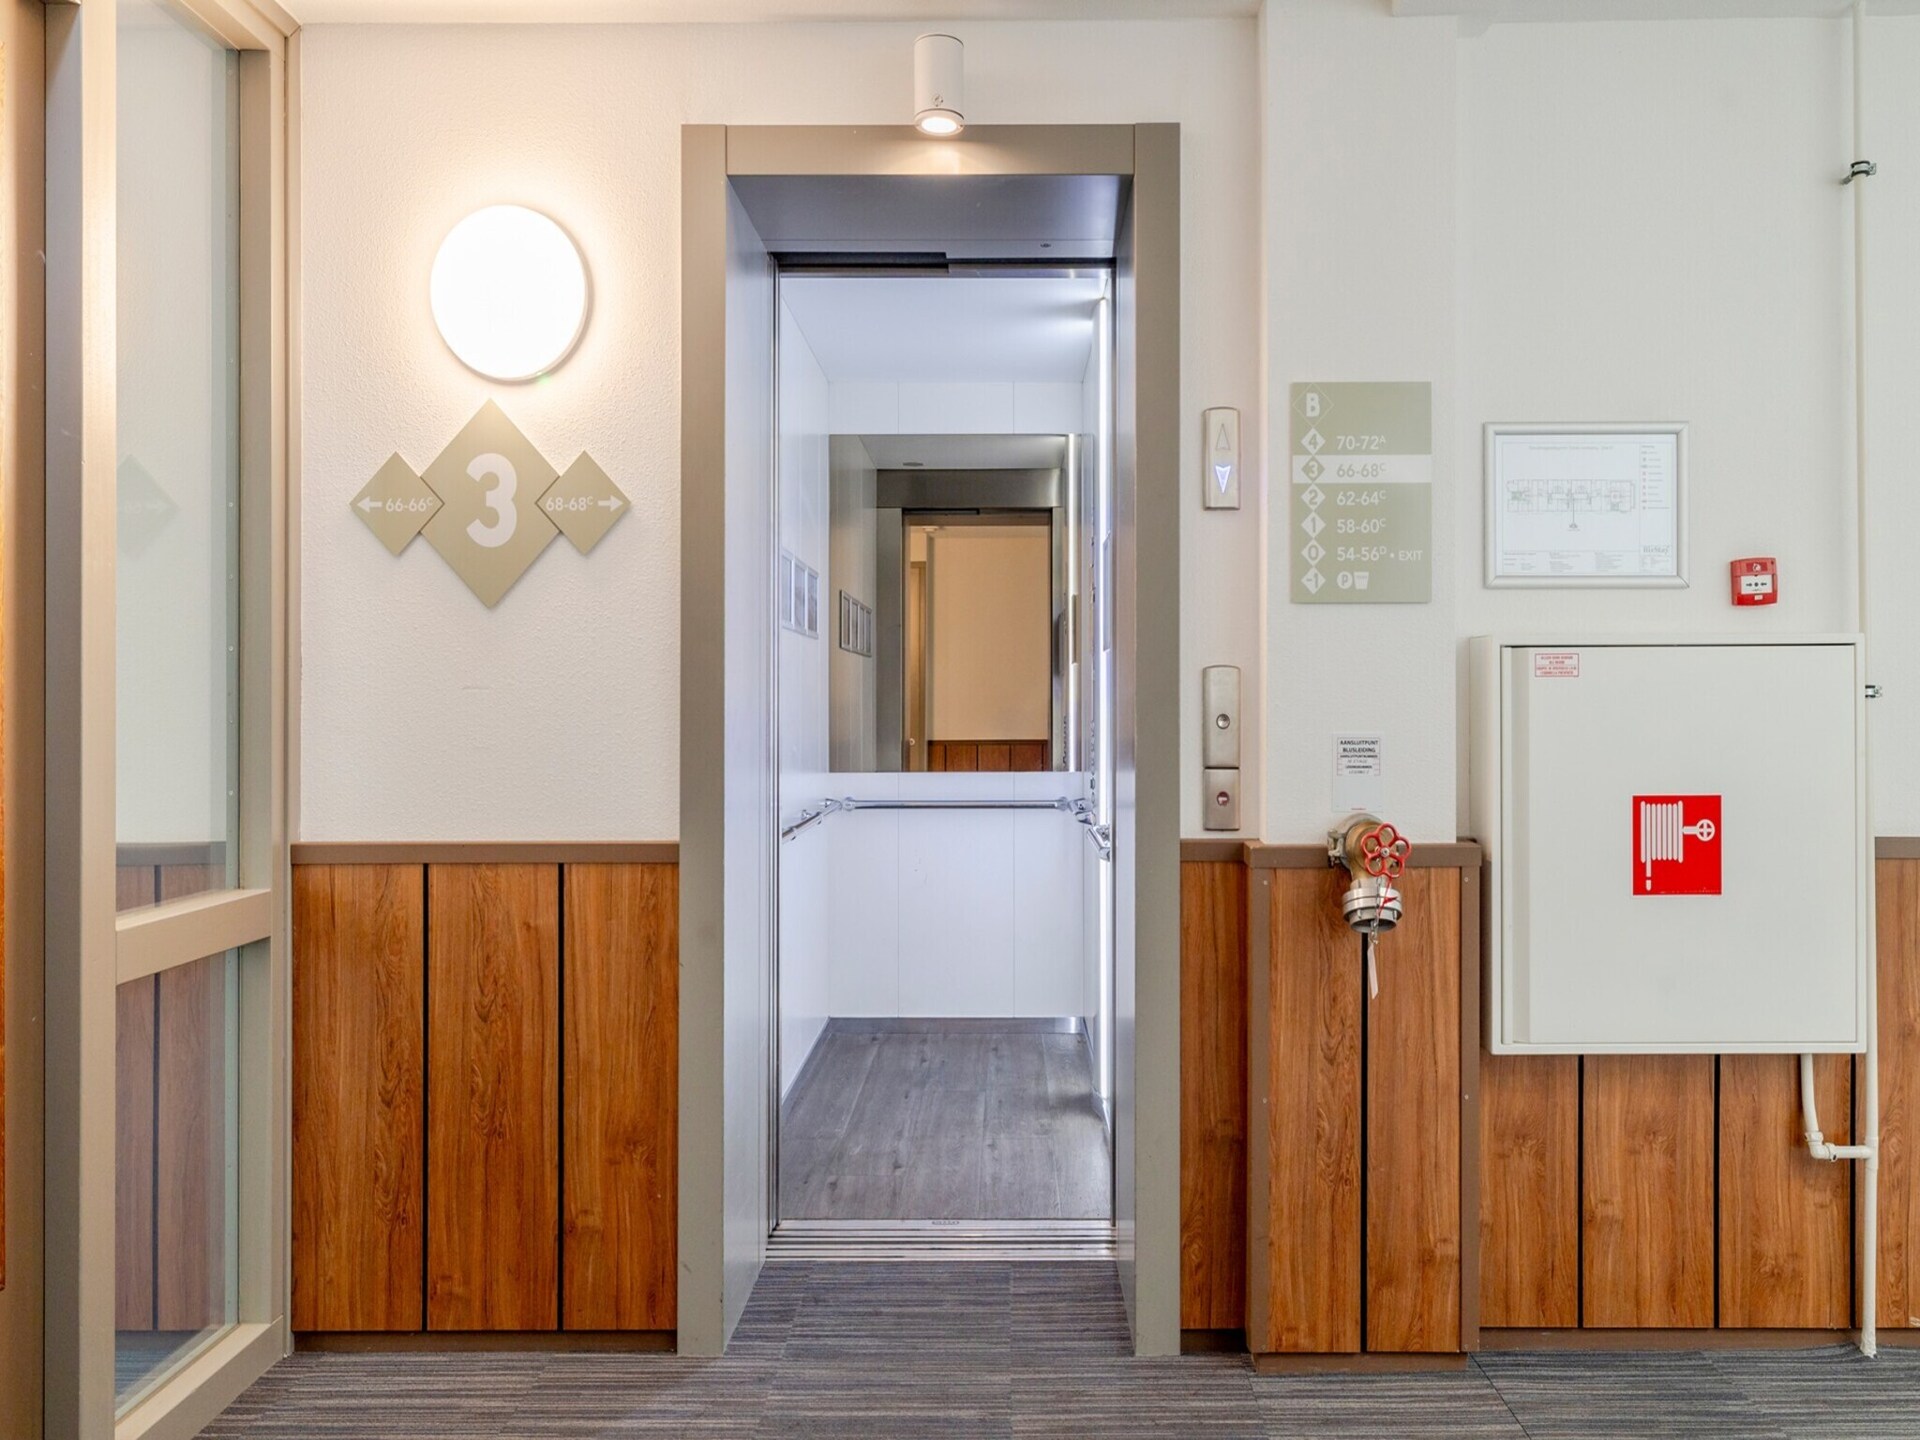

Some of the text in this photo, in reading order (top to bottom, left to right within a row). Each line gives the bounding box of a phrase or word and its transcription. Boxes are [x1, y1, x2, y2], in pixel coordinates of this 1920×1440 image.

[1305, 393, 1320, 417] B
[1308, 433, 1319, 450] 4
[1308, 461, 1319, 478] 3
[466, 452, 518, 548] 3
[1308, 489, 1319, 506] 2
[1310, 516, 1317, 533] 1
[1398, 550, 1424, 561] EXIT
[1305, 573, 1319, 589] -1
